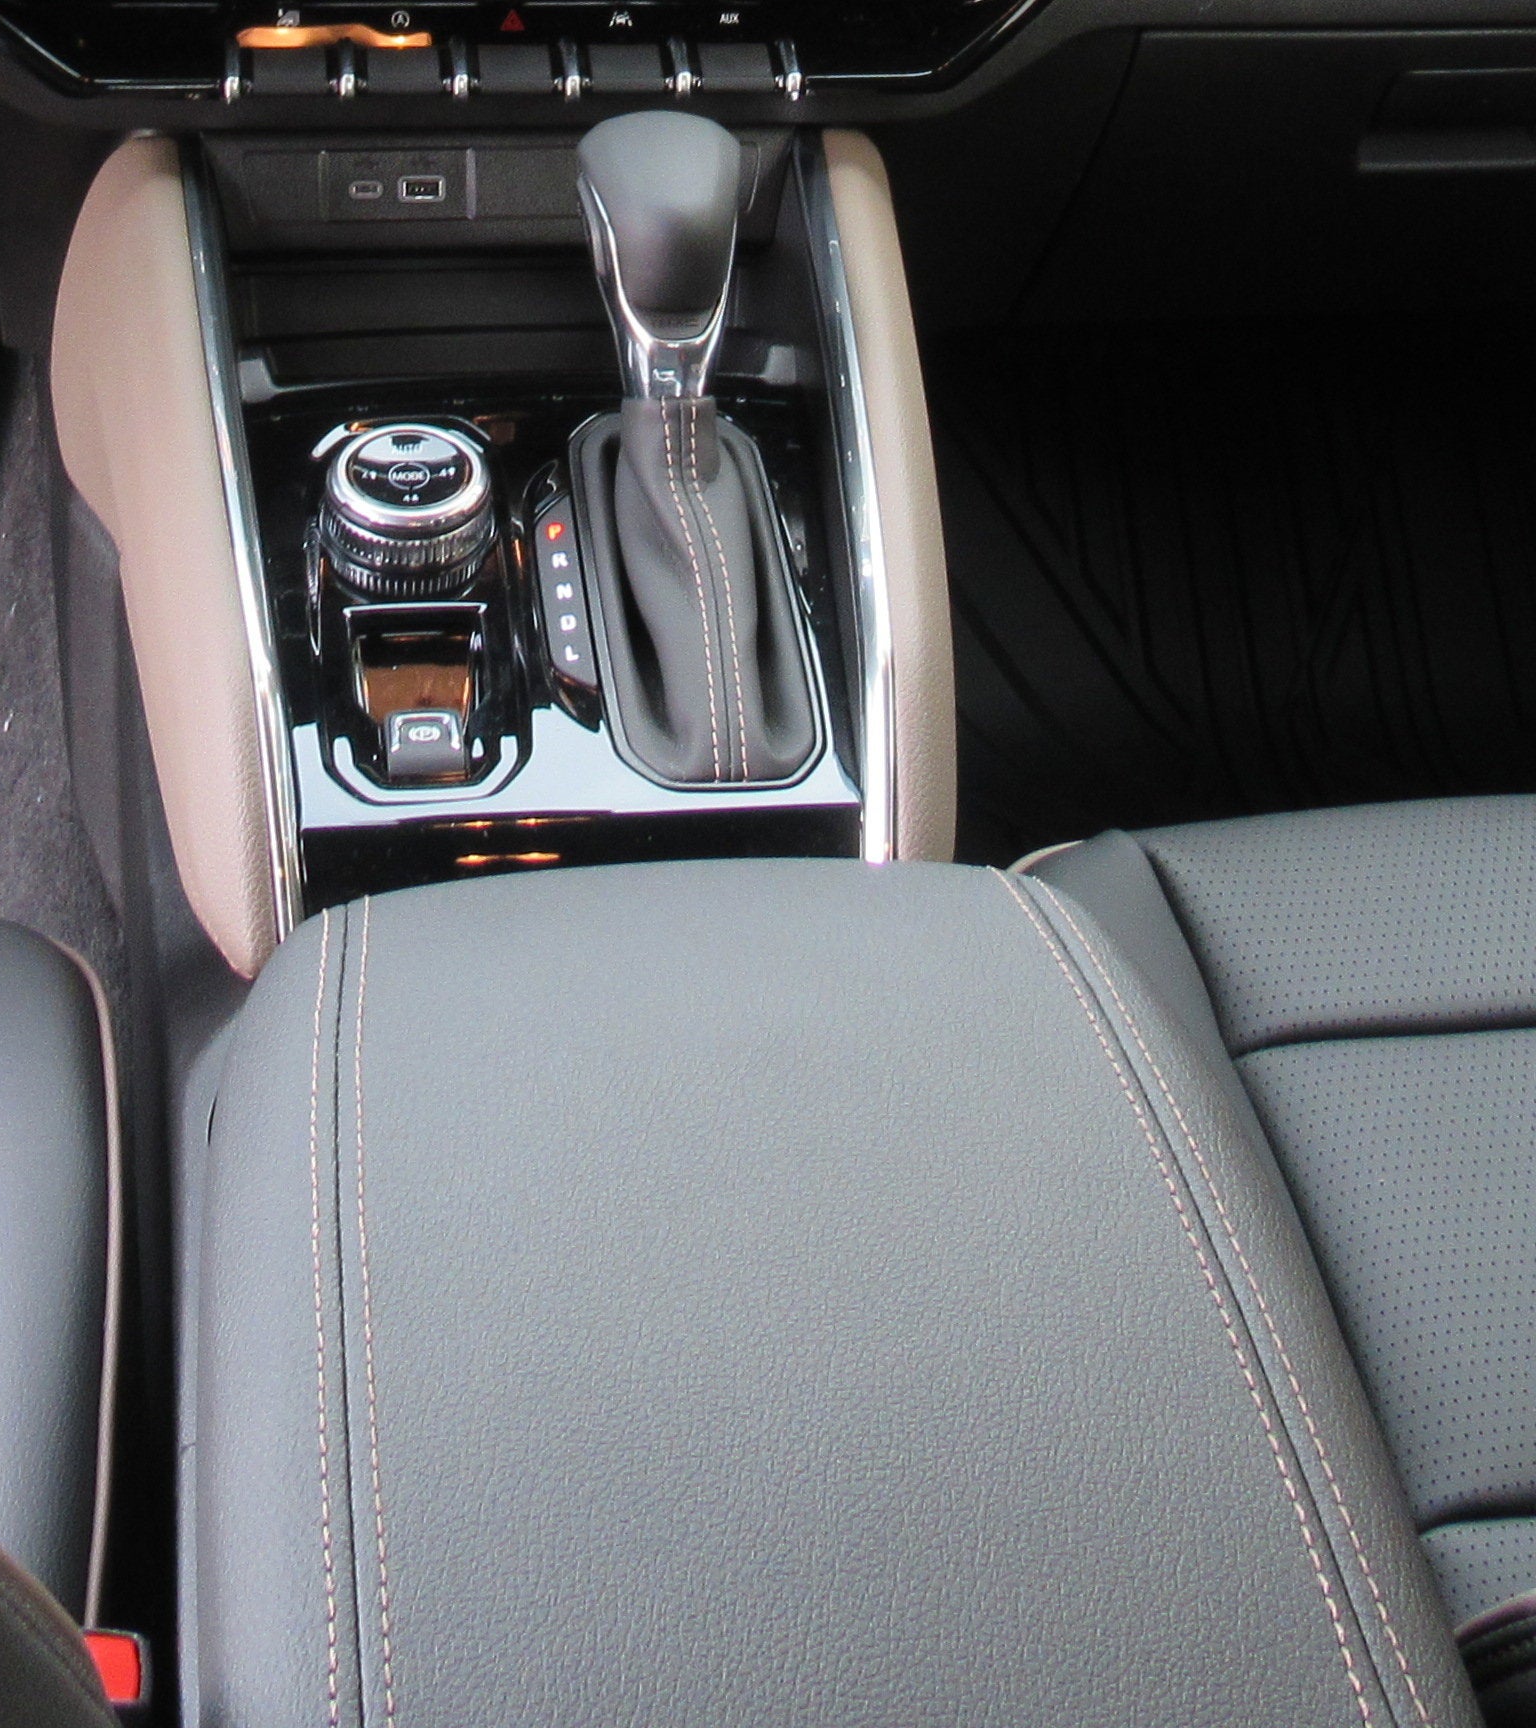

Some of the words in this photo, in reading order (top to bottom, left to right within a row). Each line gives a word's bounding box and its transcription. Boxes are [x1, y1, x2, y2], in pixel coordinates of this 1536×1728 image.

[719, 12, 740, 24] AUX
[391, 442, 423, 456] AUTO
[547, 523, 563, 541] P
[552, 551, 569, 569] R
[556, 583, 573, 600] N
[560, 614, 577, 631] D
[565, 645, 579, 662] L
